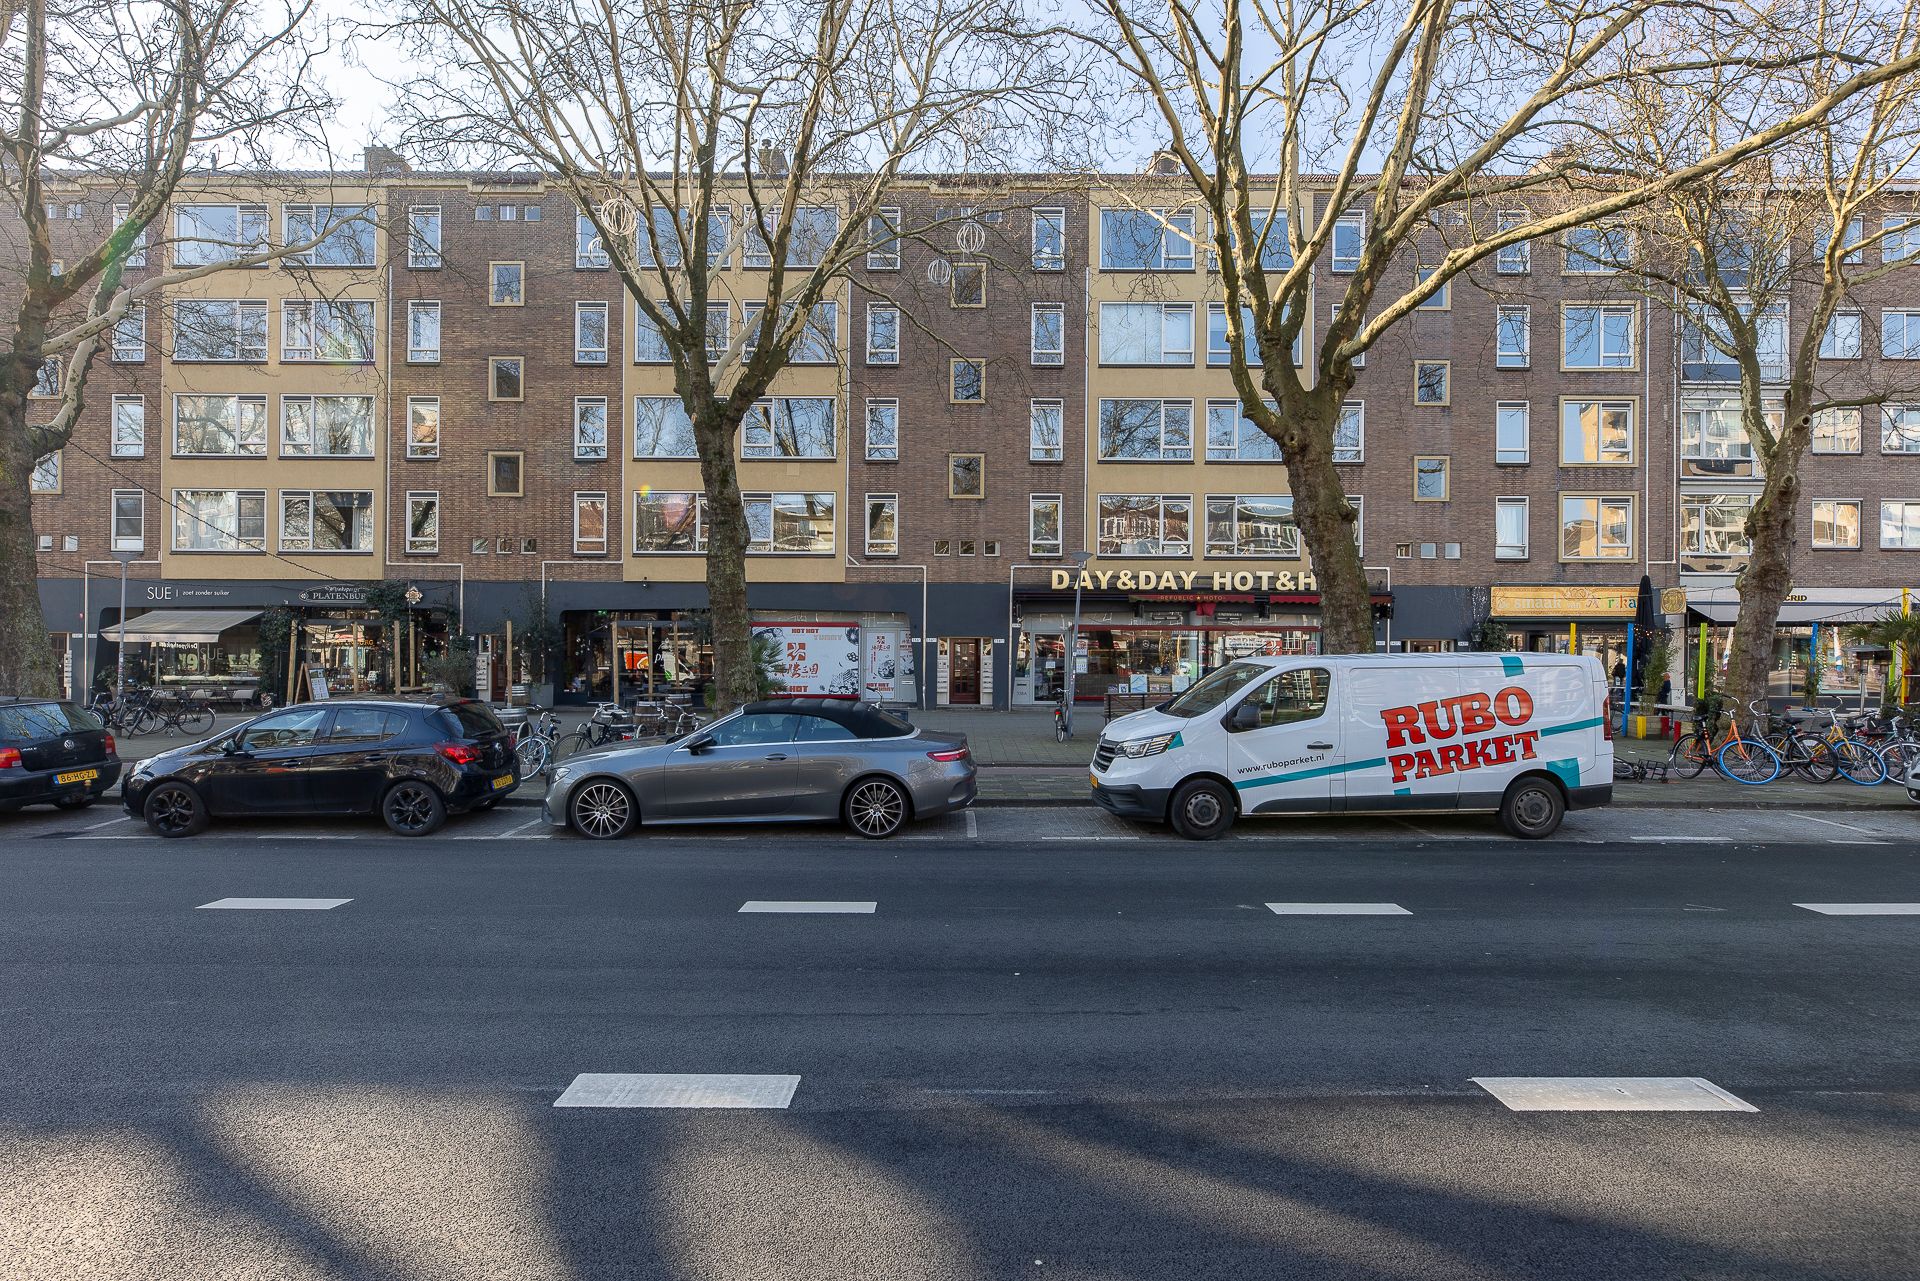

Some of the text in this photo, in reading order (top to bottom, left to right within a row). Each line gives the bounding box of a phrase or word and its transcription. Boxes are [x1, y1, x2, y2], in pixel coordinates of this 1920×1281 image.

[1051, 570, 1317, 591] DAY&DAY HOT&H
[147, 586, 172, 600] SUE
[312, 592, 367, 600] PLATENBUR
[1515, 593, 1562, 609] smaak
[1585, 594, 1637, 609] Arika
[789, 685, 808, 693] HOT
[1379, 686, 1534, 749] RUBO
[1237, 754, 1326, 775] www.ruboparket.nl
[1388, 730, 1540, 784] PARKET
